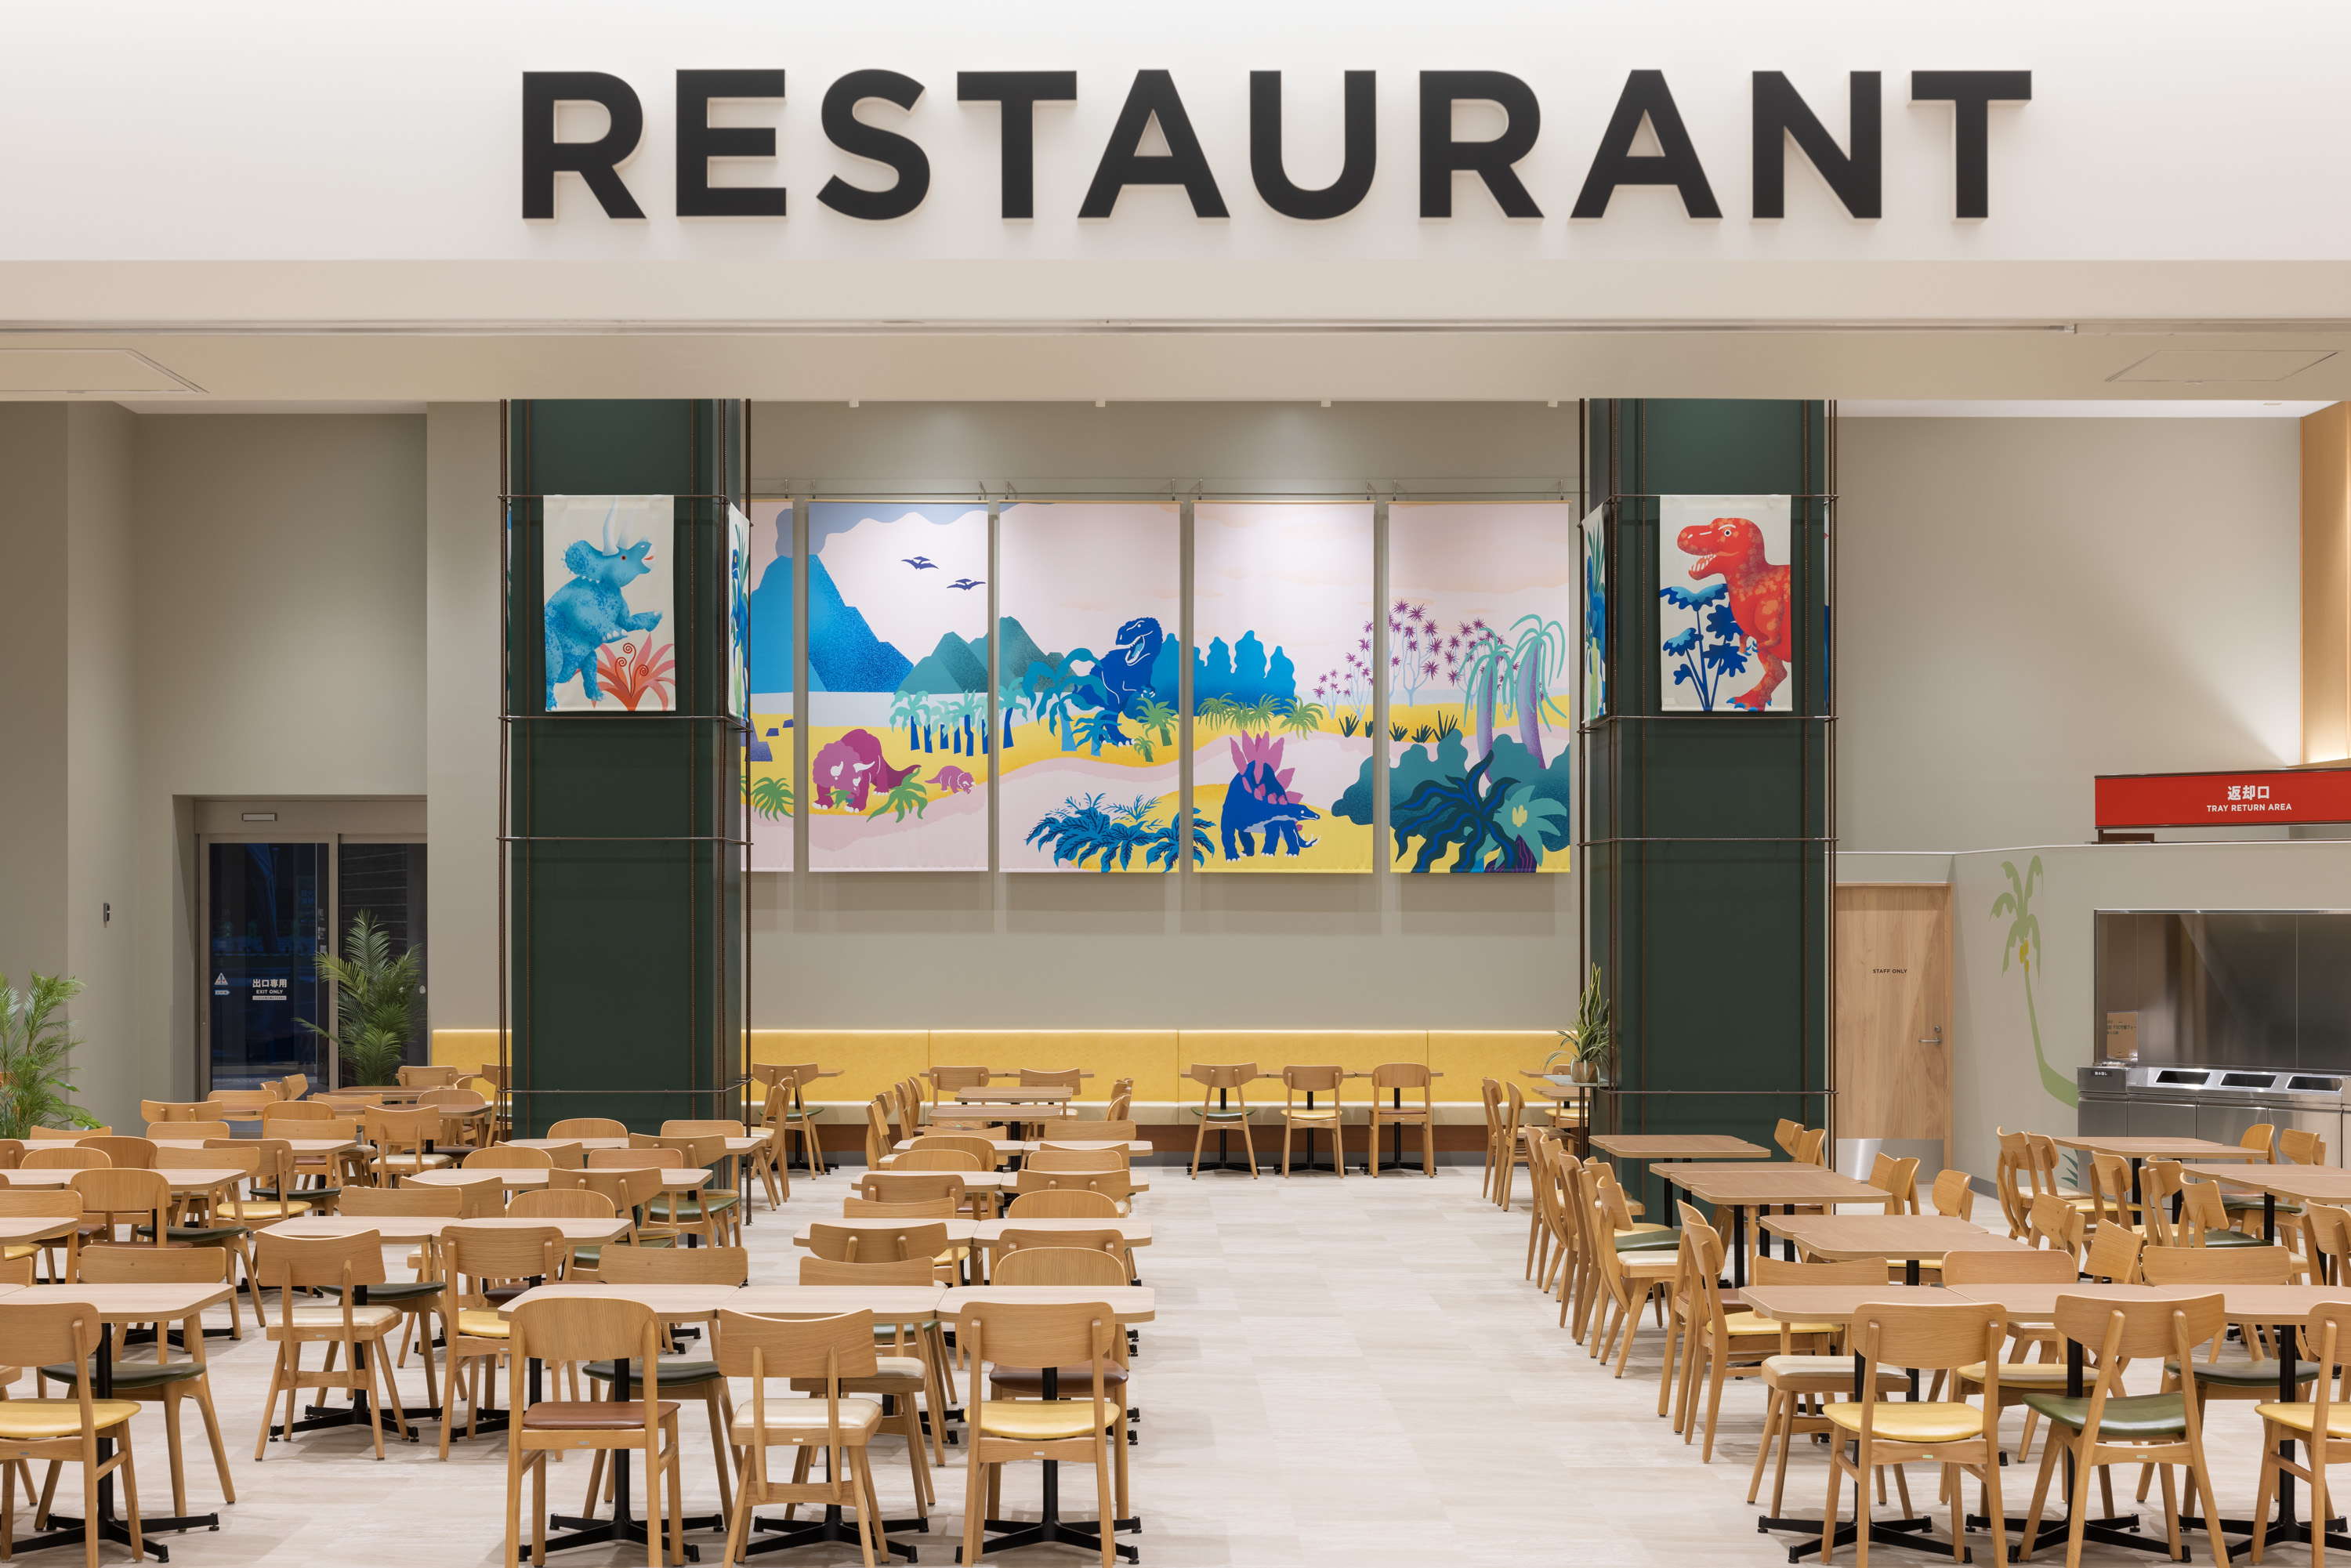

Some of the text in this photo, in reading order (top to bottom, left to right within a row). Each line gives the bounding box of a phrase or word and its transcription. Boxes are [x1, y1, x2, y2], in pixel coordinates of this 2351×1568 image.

[522, 70, 2030, 220] RESTAURANT
[2227, 784, 2269, 800] 返却口
[252, 979, 287, 987] 出口専用
